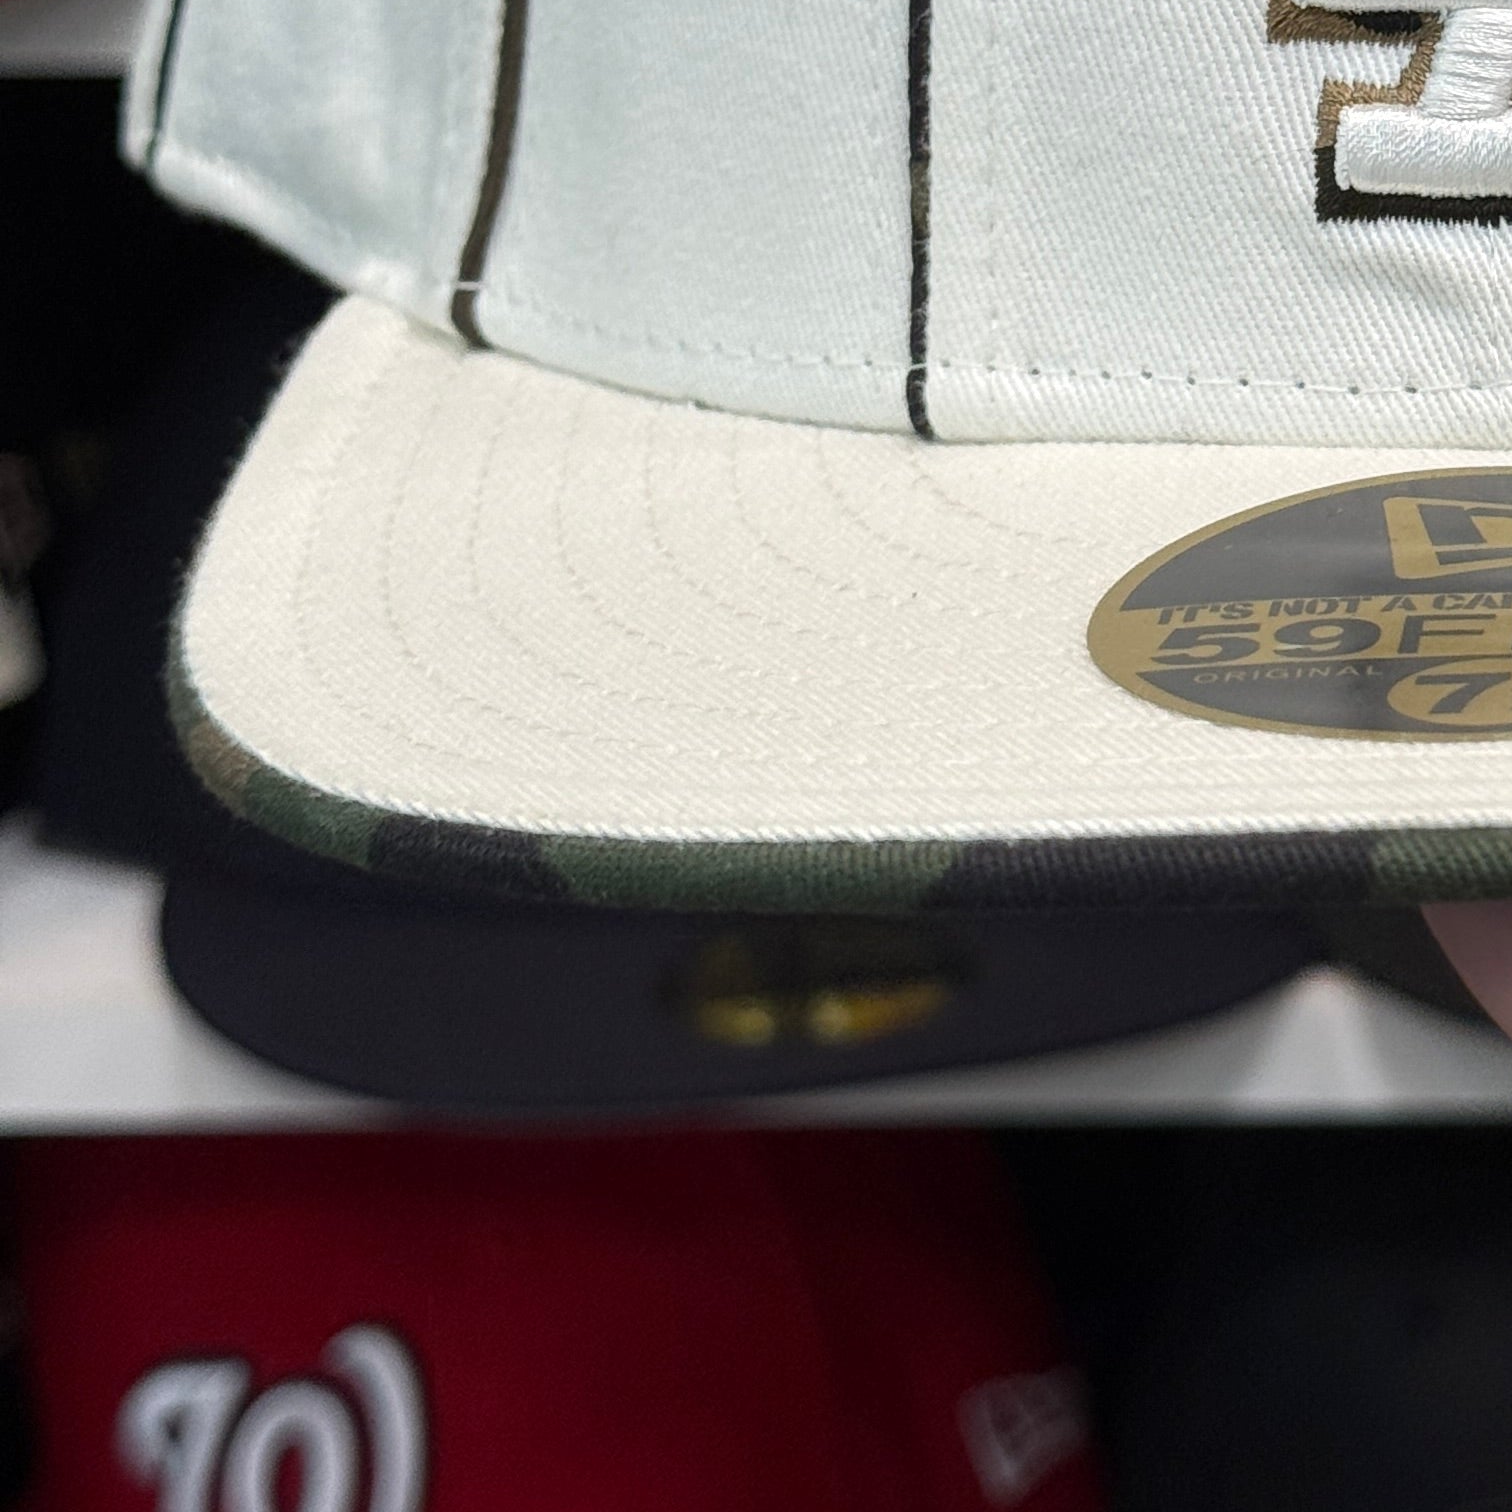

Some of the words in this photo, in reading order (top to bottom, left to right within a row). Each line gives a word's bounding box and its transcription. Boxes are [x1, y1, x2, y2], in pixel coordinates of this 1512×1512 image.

[1157, 601, 1254, 625] IT'S
[1268, 595, 1373, 618] NOT
[1380, 594, 1417, 612] A
[1193, 664, 1384, 684] ORIGINAL
